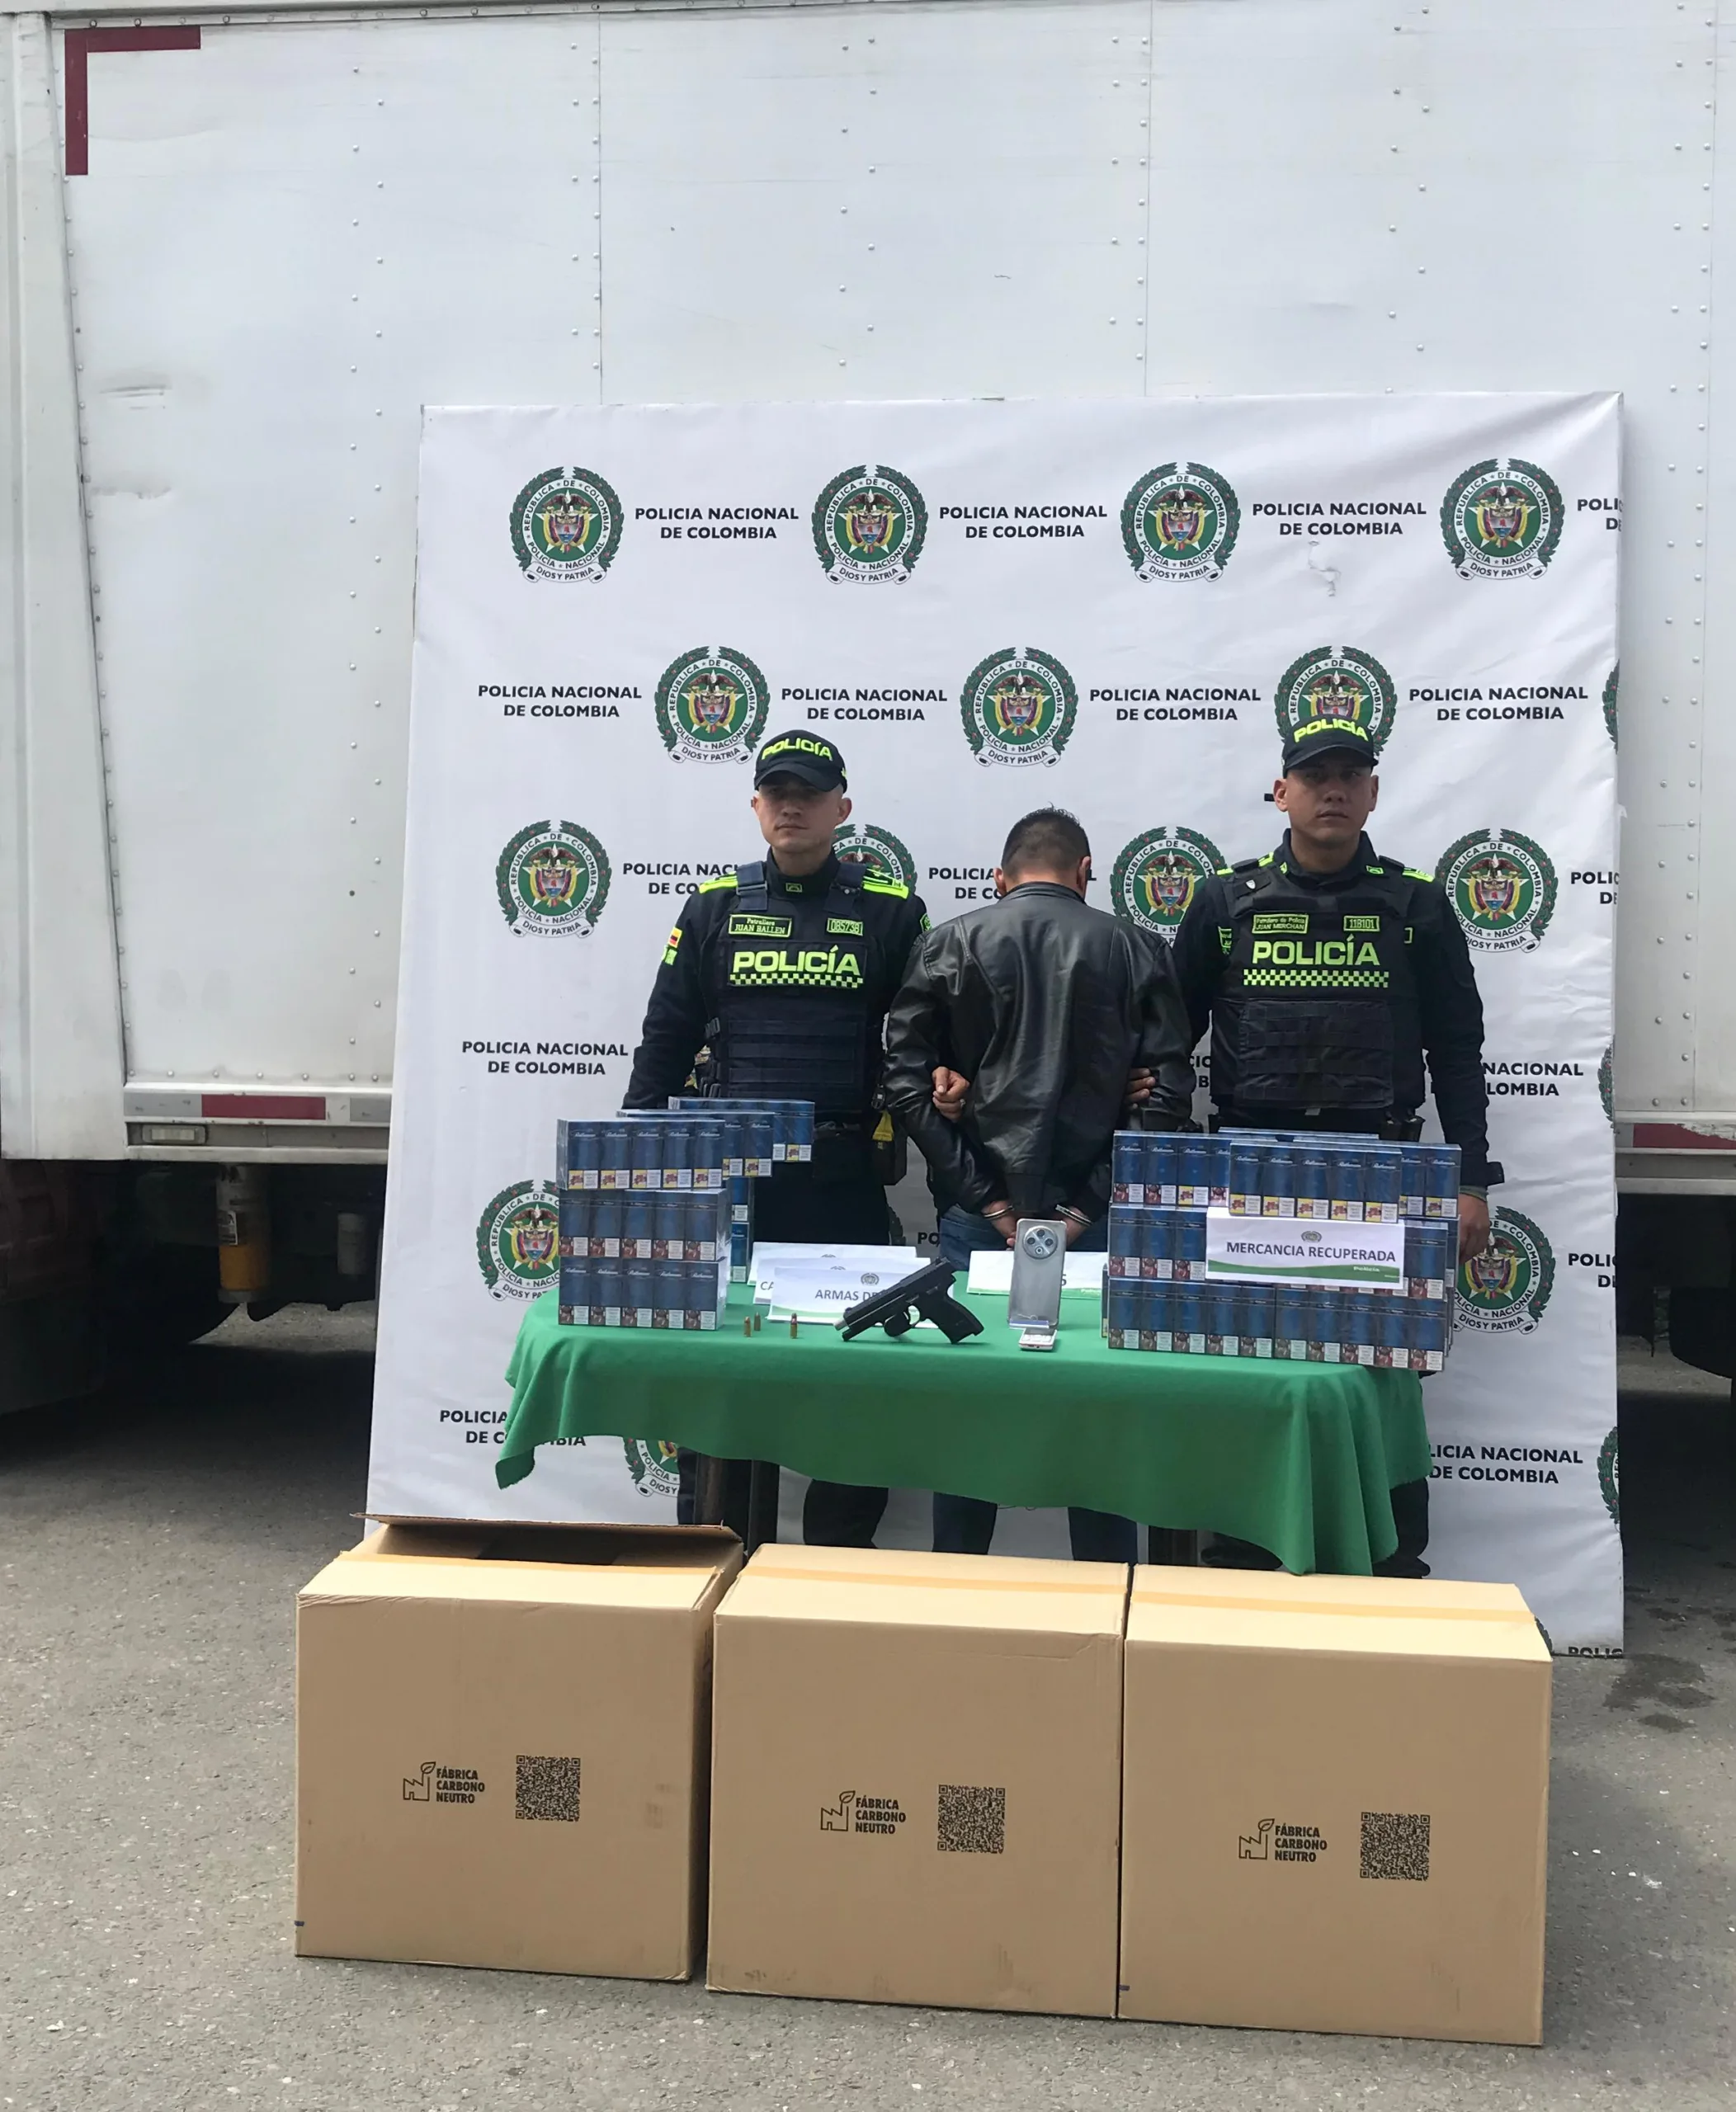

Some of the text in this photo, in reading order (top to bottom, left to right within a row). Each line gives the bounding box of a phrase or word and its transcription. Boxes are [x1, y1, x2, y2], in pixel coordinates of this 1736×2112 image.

[563, 479, 576, 488] DE
[583, 485, 610, 532] COLOMBIA
[866, 478, 913, 532] DE COLOMBIA
[1176, 474, 1190, 483] DE
[1198, 480, 1225, 529] COLOMBIA
[1498, 471, 1549, 526] DE COLOMBIA
[635, 507, 800, 520] POLICIA NACIONAL
[939, 506, 1107, 520] POLICIA NACIONAL
[1252, 502, 1427, 516] POLICIA NACIONAL
[660, 526, 777, 539] DE COLOMBIA
[965, 526, 1085, 539] DE COLOMBIA
[1280, 522, 1403, 535] DE COLOMBIA
[565, 541, 605, 569] NACIONAL
[868, 541, 909, 570] NACIONAL
[1179, 538, 1221, 568] NACIONAL
[1501, 535, 1545, 565] NACIONAL
[564, 566, 595, 581] PATRIA
[868, 568, 899, 582] PATRIA
[1178, 564, 1210, 579] PATRIA
[1501, 562, 1534, 577] PATRIA
[478, 686, 642, 699] POLICIA NACIONAL
[708, 659, 756, 712] DE COLOMBIA
[1015, 660, 1028, 668] DE
[1036, 666, 1064, 714] COLOMBIA
[1331, 659, 1381, 714] DE COLOMBIA
[781, 688, 948, 702] POLICIA NACIONAL
[1090, 688, 1262, 702] POLICIA NACIONAL
[1409, 686, 1588, 701] POLICIA NACIONAL
[503, 705, 620, 718] DE COLOMBIA
[807, 707, 925, 721] DE COLOMBIA
[1116, 708, 1238, 721] DE COLOMBIA
[1436, 706, 1564, 721] DE COLOMBIA
[710, 721, 751, 750] NACIONAL
[1017, 724, 1059, 752] NACIONAL
[710, 747, 741, 761] PATRIA
[1017, 750, 1049, 764] PATRIA
[854, 837, 868, 846] DE
[1165, 840, 1179, 848] DE
[570, 839, 597, 887] COLOMBIA
[623, 863, 691, 875] POLICIA
[1489, 842, 1541, 898] DE COLOMBIA
[649, 882, 670, 894] DE
[955, 887, 977, 899] DE
[552, 895, 592, 924] NACIONAL
[551, 922, 582, 936] PATRIA
[734, 923, 755, 932] JUAN
[1493, 908, 1538, 938] NACIONAL
[1252, 933, 1380, 965] POLICÍA
[1493, 935, 1527, 950] PATRIA
[733, 944, 861, 976] POLICÍA
[462, 1041, 629, 1057] POLICIA NACIONAL
[488, 1061, 606, 1075] DE COLOMBIA
[1483, 1062, 1584, 1077] NACIONAL
[1486, 1082, 1559, 1096] LOMBIA
[532, 1193, 545, 1201] DE
[1226, 1242, 1396, 1262] MERCANCIA RECUPERADA
[1509, 1227, 1539, 1278] COLOMBIA
[814, 1289, 860, 1301] ARMAS
[1490, 1288, 1536, 1318] NACIONAL
[1491, 1315, 1525, 1331] PATRIA
[465, 1431, 488, 1444] DE
[1481, 1446, 1583, 1464] NACIONAL
[1458, 1467, 1559, 1484] COLOMBIA
[436, 1766, 479, 1780] FÁBRICA
[436, 1780, 485, 1793] CARBONO
[436, 1792, 475, 1803] NEUTRO
[856, 1795, 899, 1809] FÁBRICA
[855, 1809, 907, 1822] CARBONO
[855, 1822, 896, 1834] NEUTRO
[1275, 1823, 1320, 1838] FÁBRICA
[1274, 1838, 1328, 1850] CARBONO
[1274, 1850, 1317, 1863] NEUTRO
